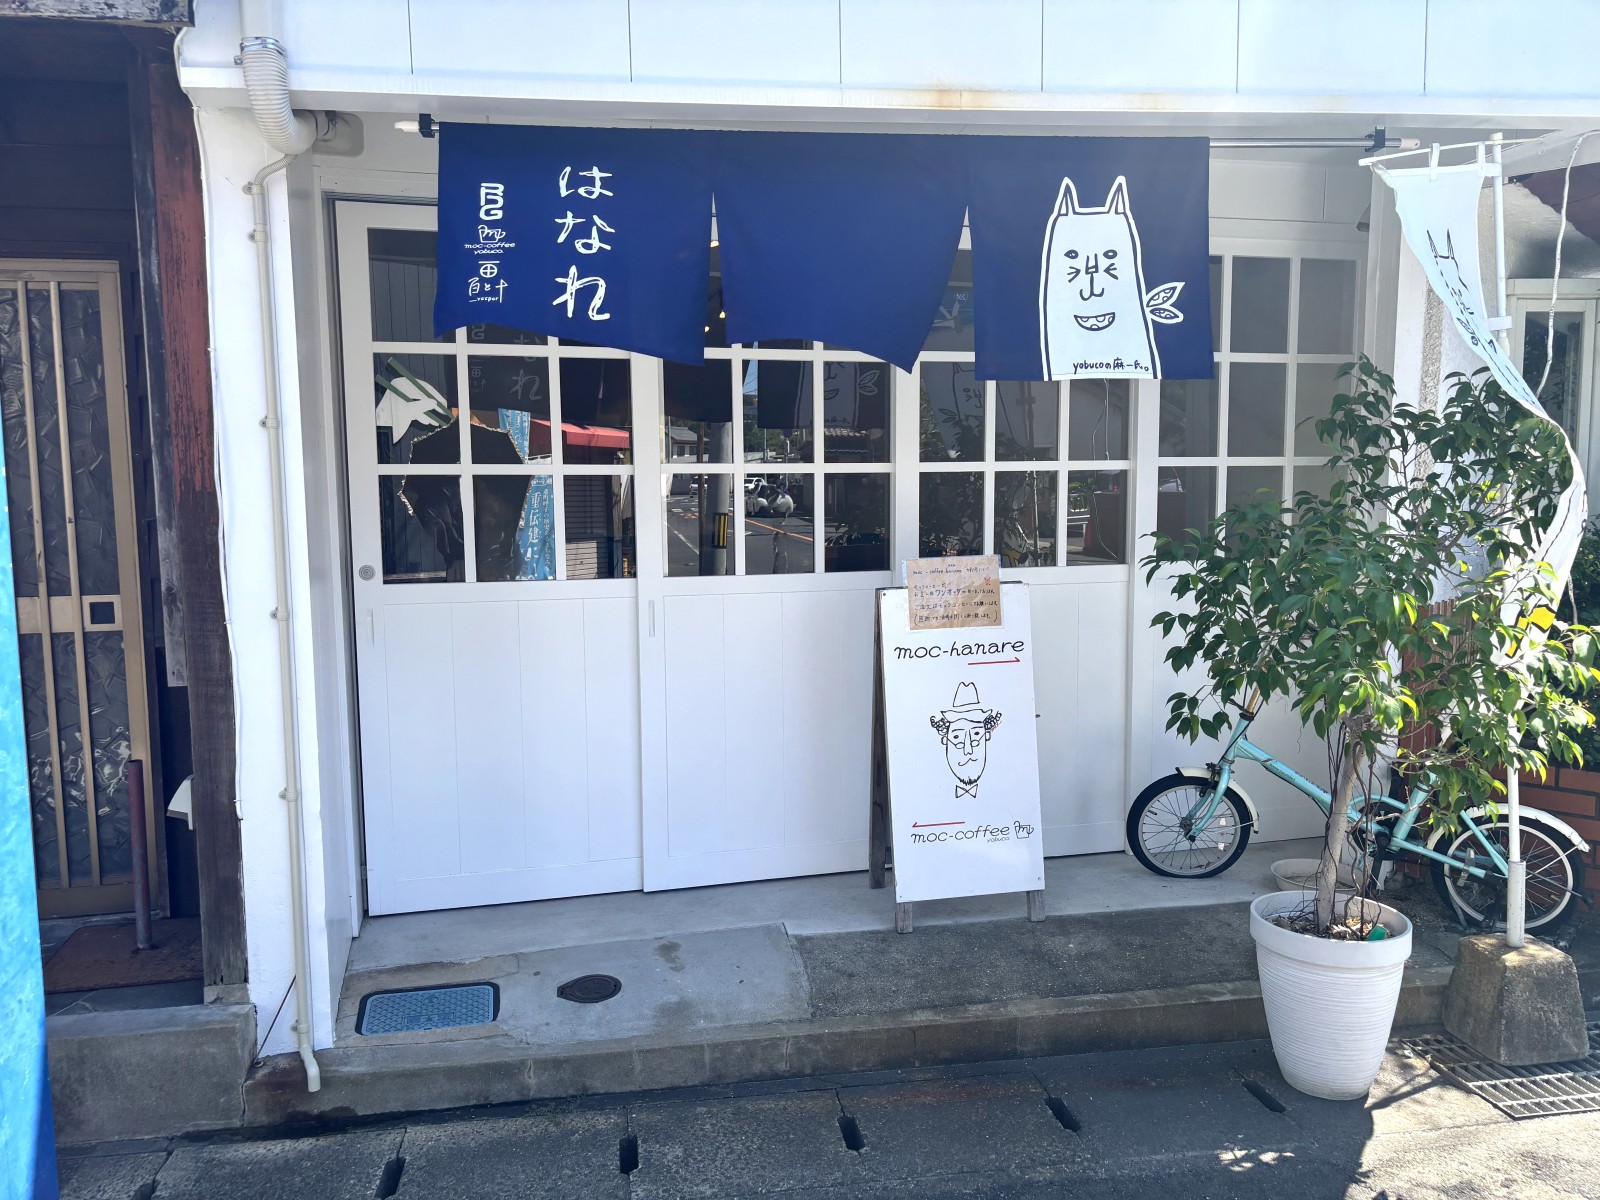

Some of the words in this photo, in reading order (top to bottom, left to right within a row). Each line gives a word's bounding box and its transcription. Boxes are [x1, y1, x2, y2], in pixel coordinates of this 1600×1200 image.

[463, 242, 516, 250] moc-coffee
[552, 165, 616, 321] はなれ
[894, 640, 1025, 660] moc-hanare
[910, 824, 1010, 844] moc-coffee
